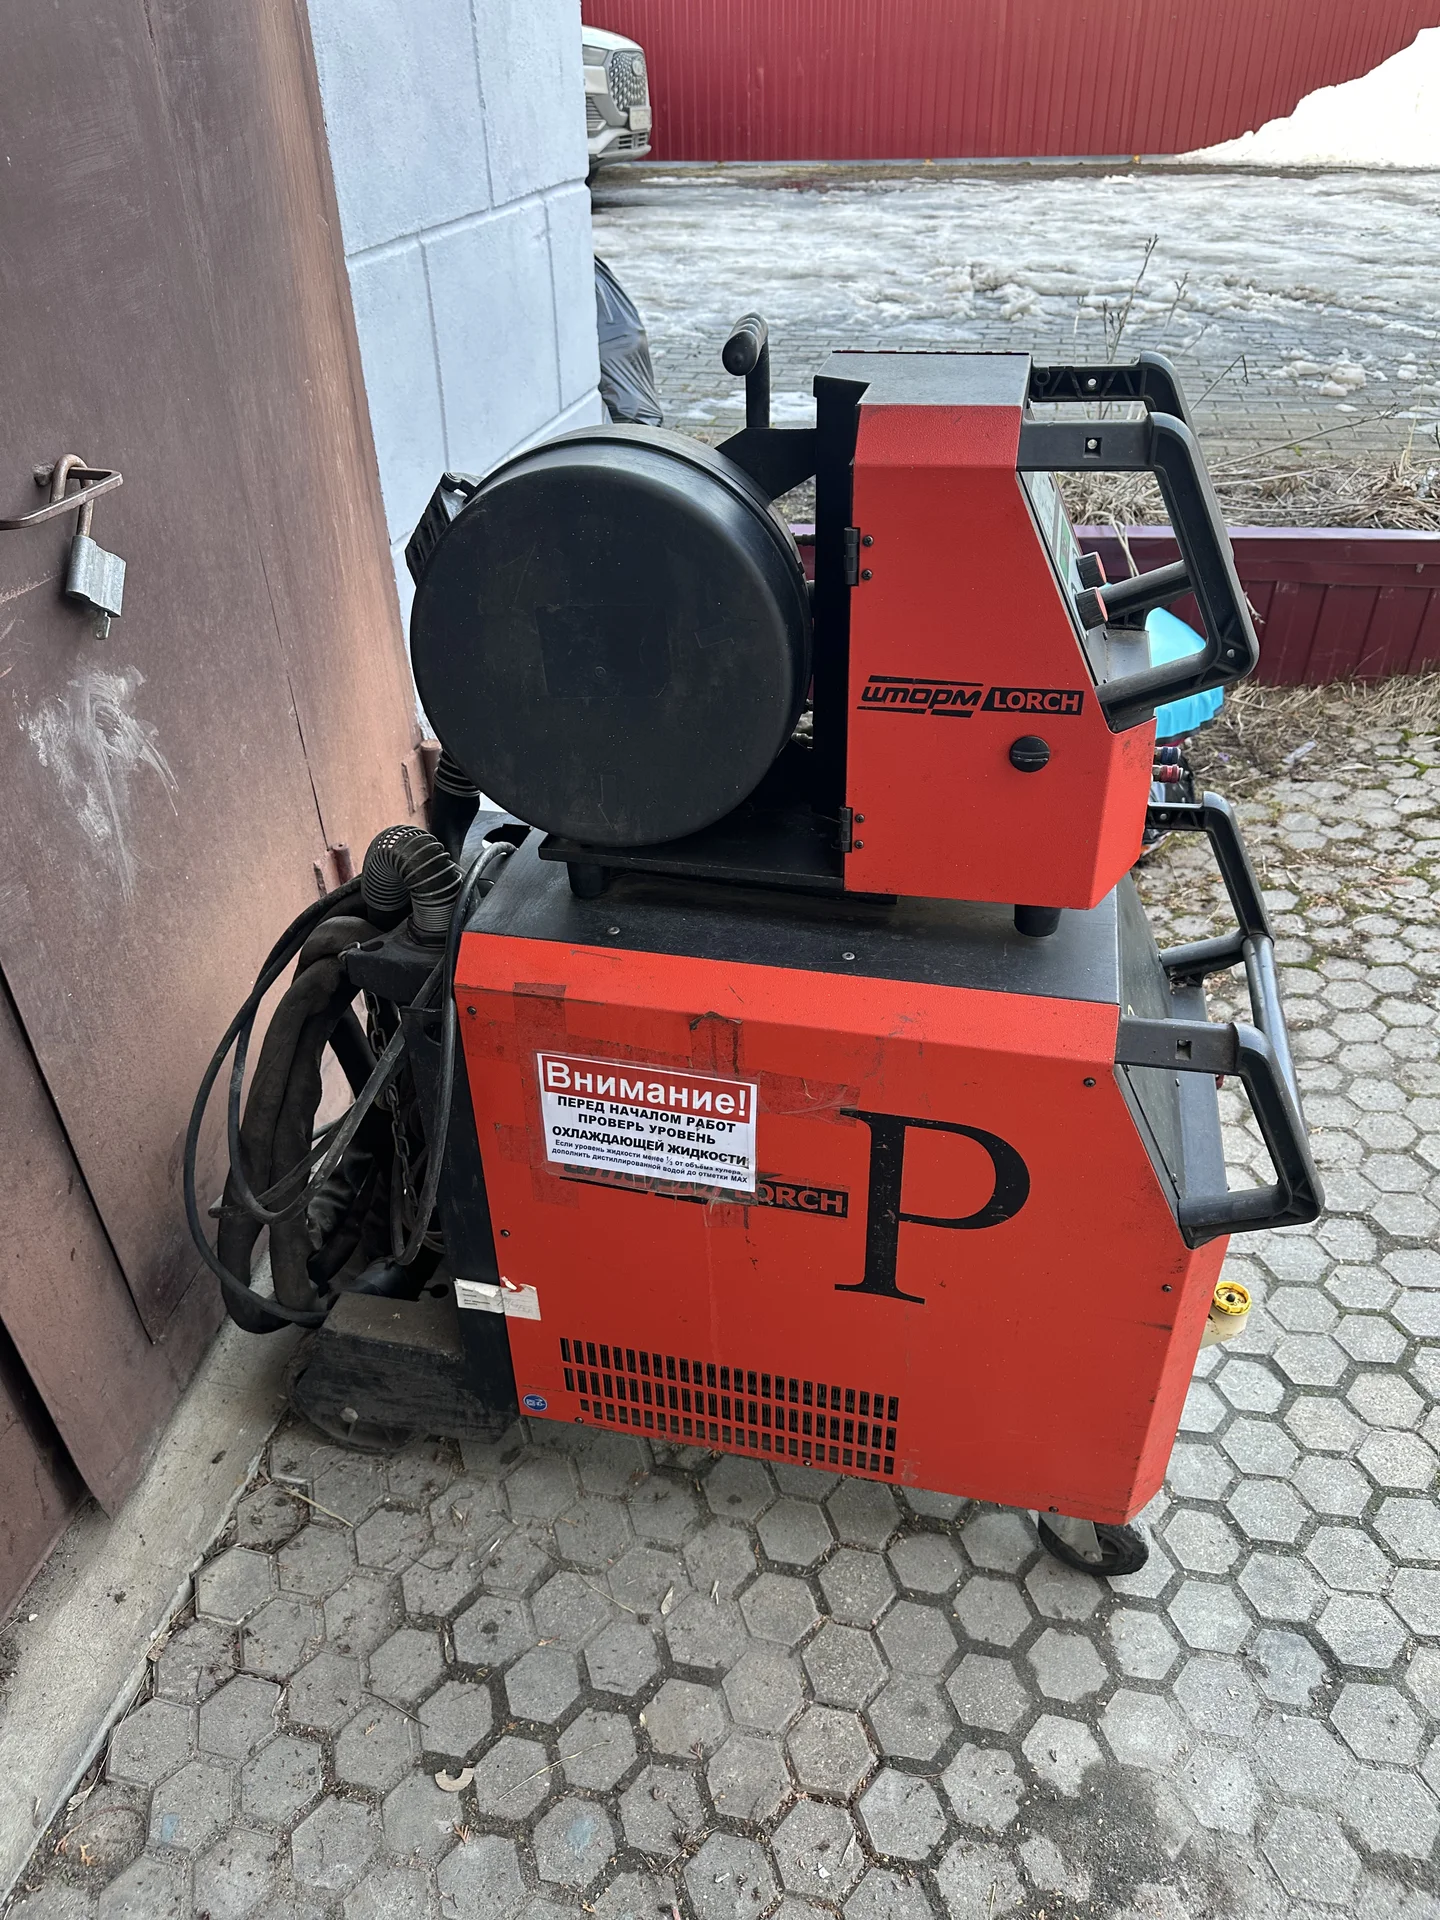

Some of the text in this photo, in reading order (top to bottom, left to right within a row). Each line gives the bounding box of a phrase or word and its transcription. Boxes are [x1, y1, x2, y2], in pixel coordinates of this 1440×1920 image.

[992, 691, 1081, 712] LORCH
[546, 1061, 746, 1117] Внимание!
[557, 1095, 736, 1133] ПЕРЕД НАЧАЛОМ РАБОТ
[578, 1113, 716, 1145] ПРОВЕРЬ УРОВЕНЬ
[552, 1126, 664, 1152] ОХЛАЖДАЮЩЕЙ
[555, 1139, 573, 1148] Если
[575, 1142, 605, 1153] уровень
[606, 1148, 641, 1159] жидкости
[643, 1155, 665, 1163] менее
[552, 1148, 591, 1159] дополнить
[592, 1153, 661, 1170] дистиллированной
[662, 1166, 685, 1175] водой
[698, 1171, 729, 1181] отметки
